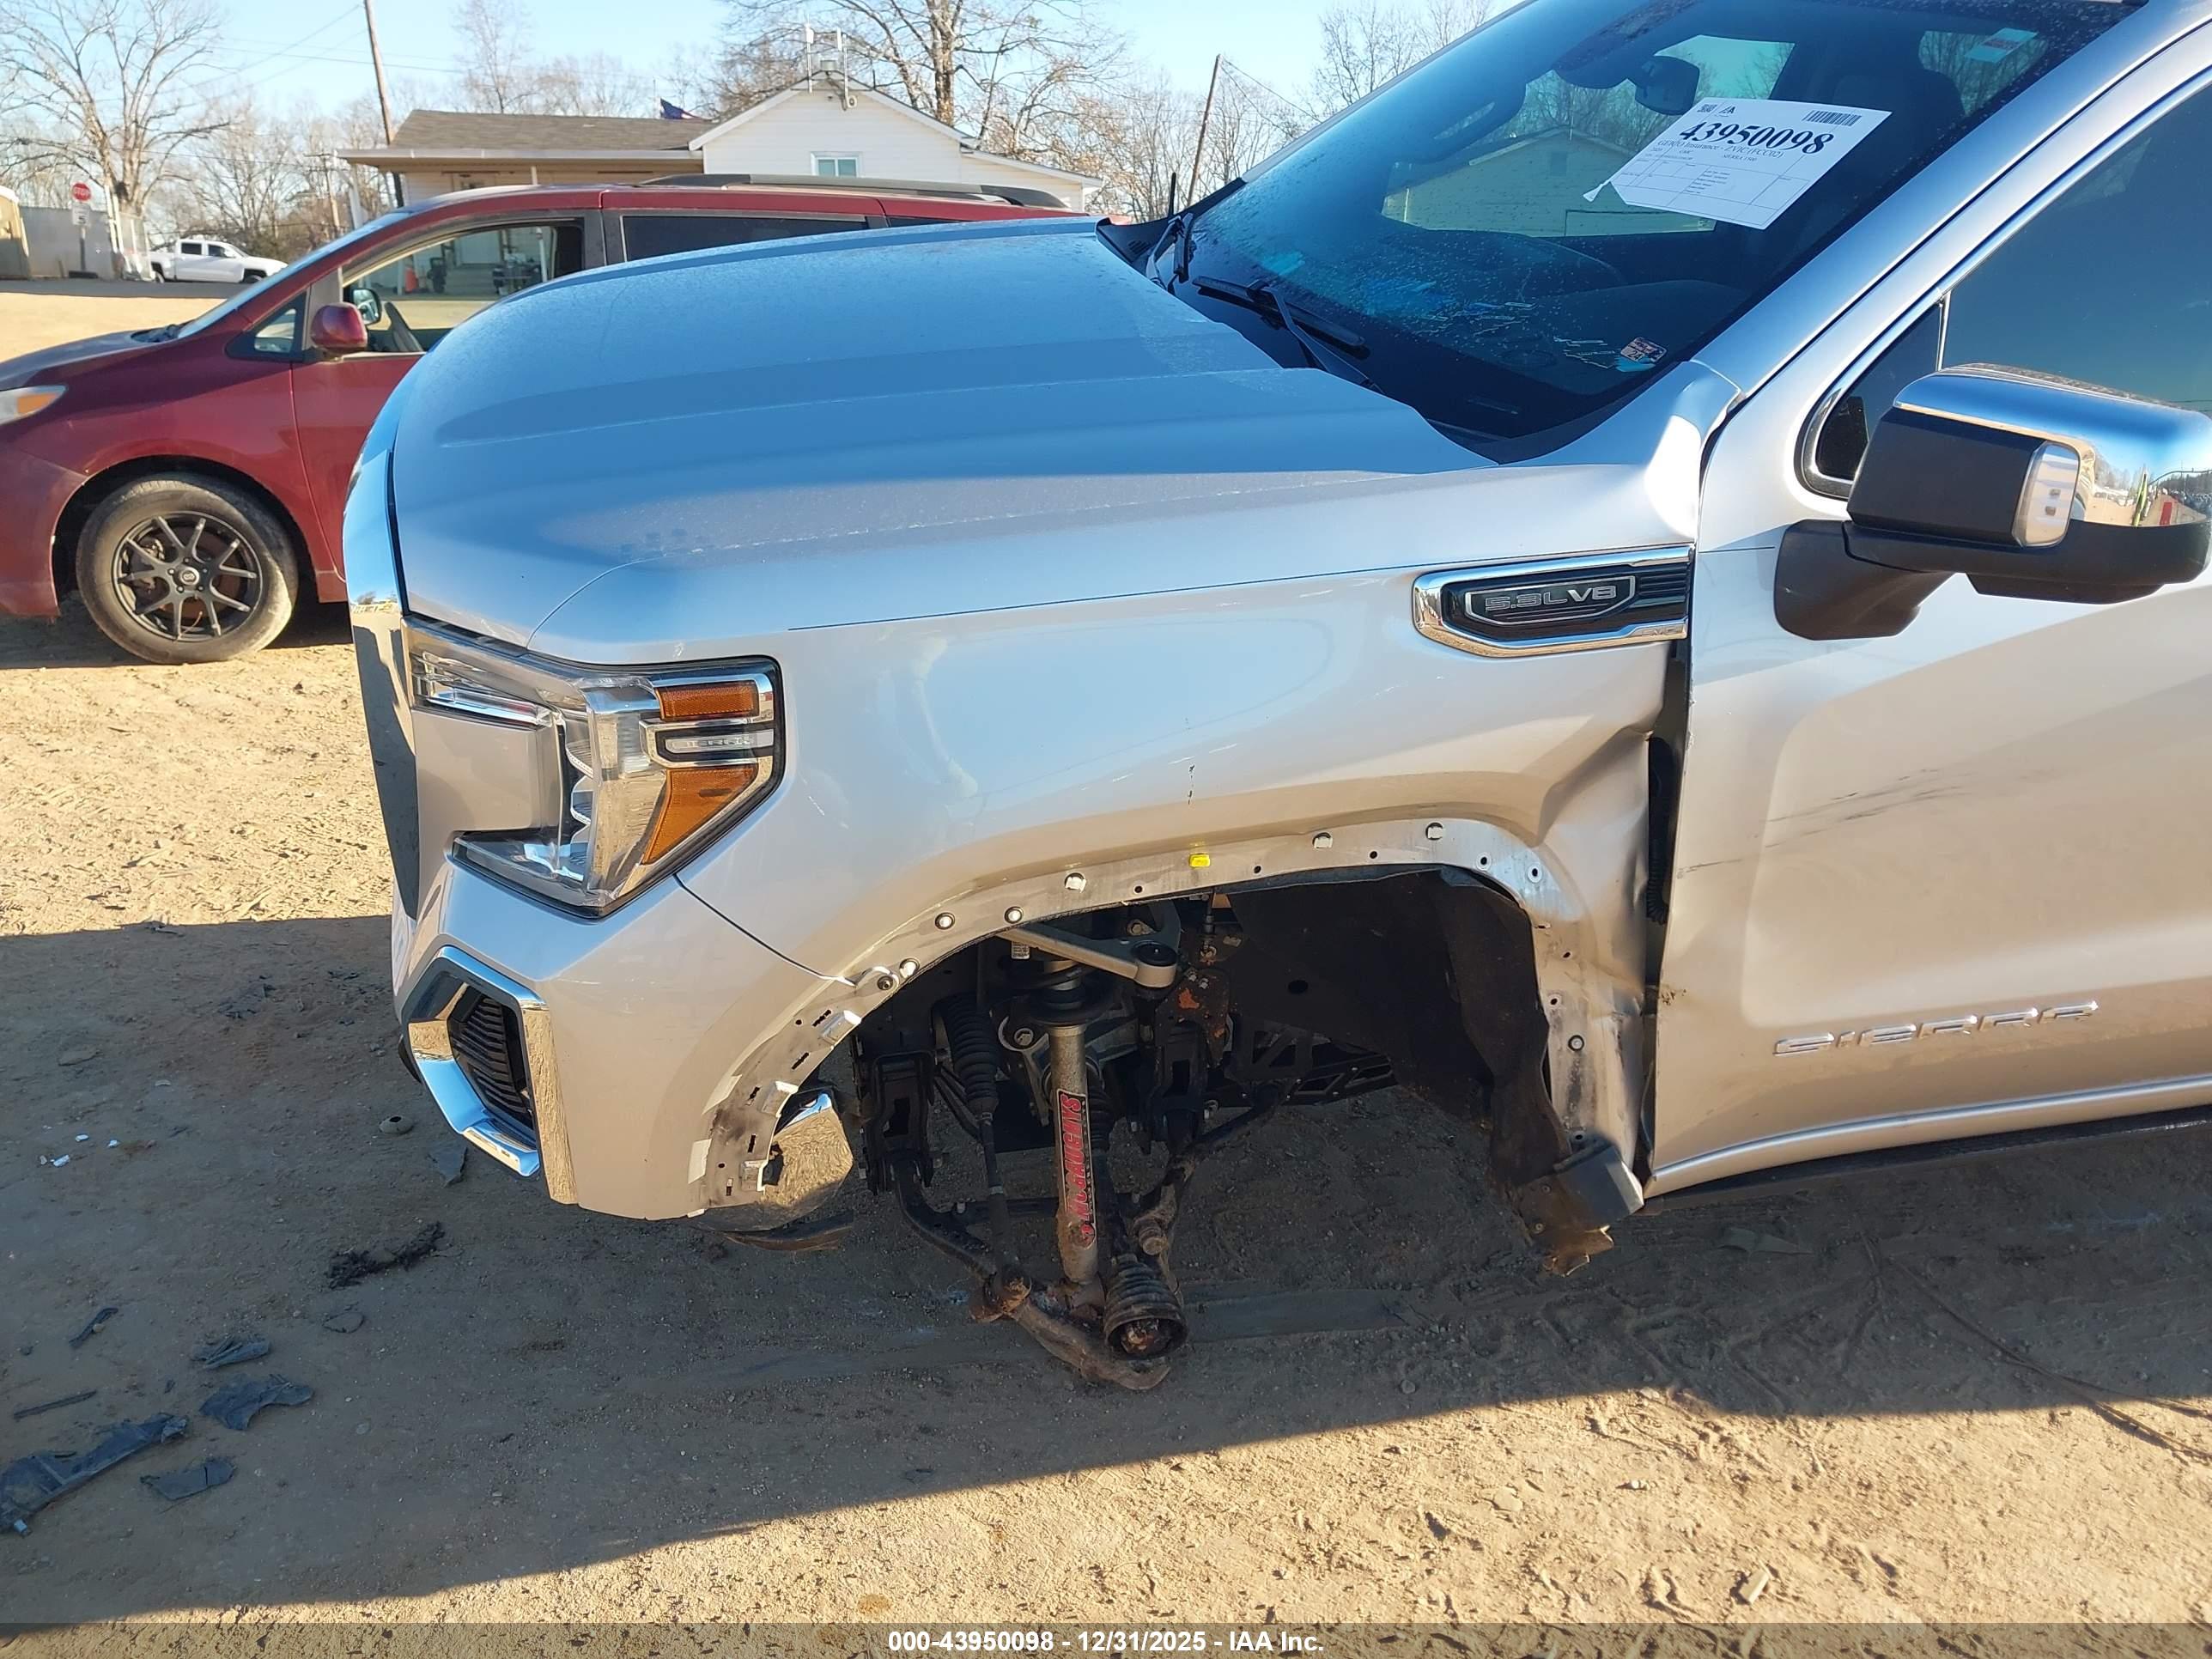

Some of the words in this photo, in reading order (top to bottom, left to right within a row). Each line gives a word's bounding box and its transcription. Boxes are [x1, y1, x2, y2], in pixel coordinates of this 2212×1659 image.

[1680, 121, 1834, 155] 43950098
[1685, 142, 1719, 150] Insurance
[1772, 1000, 2098, 1056] SIERRA
